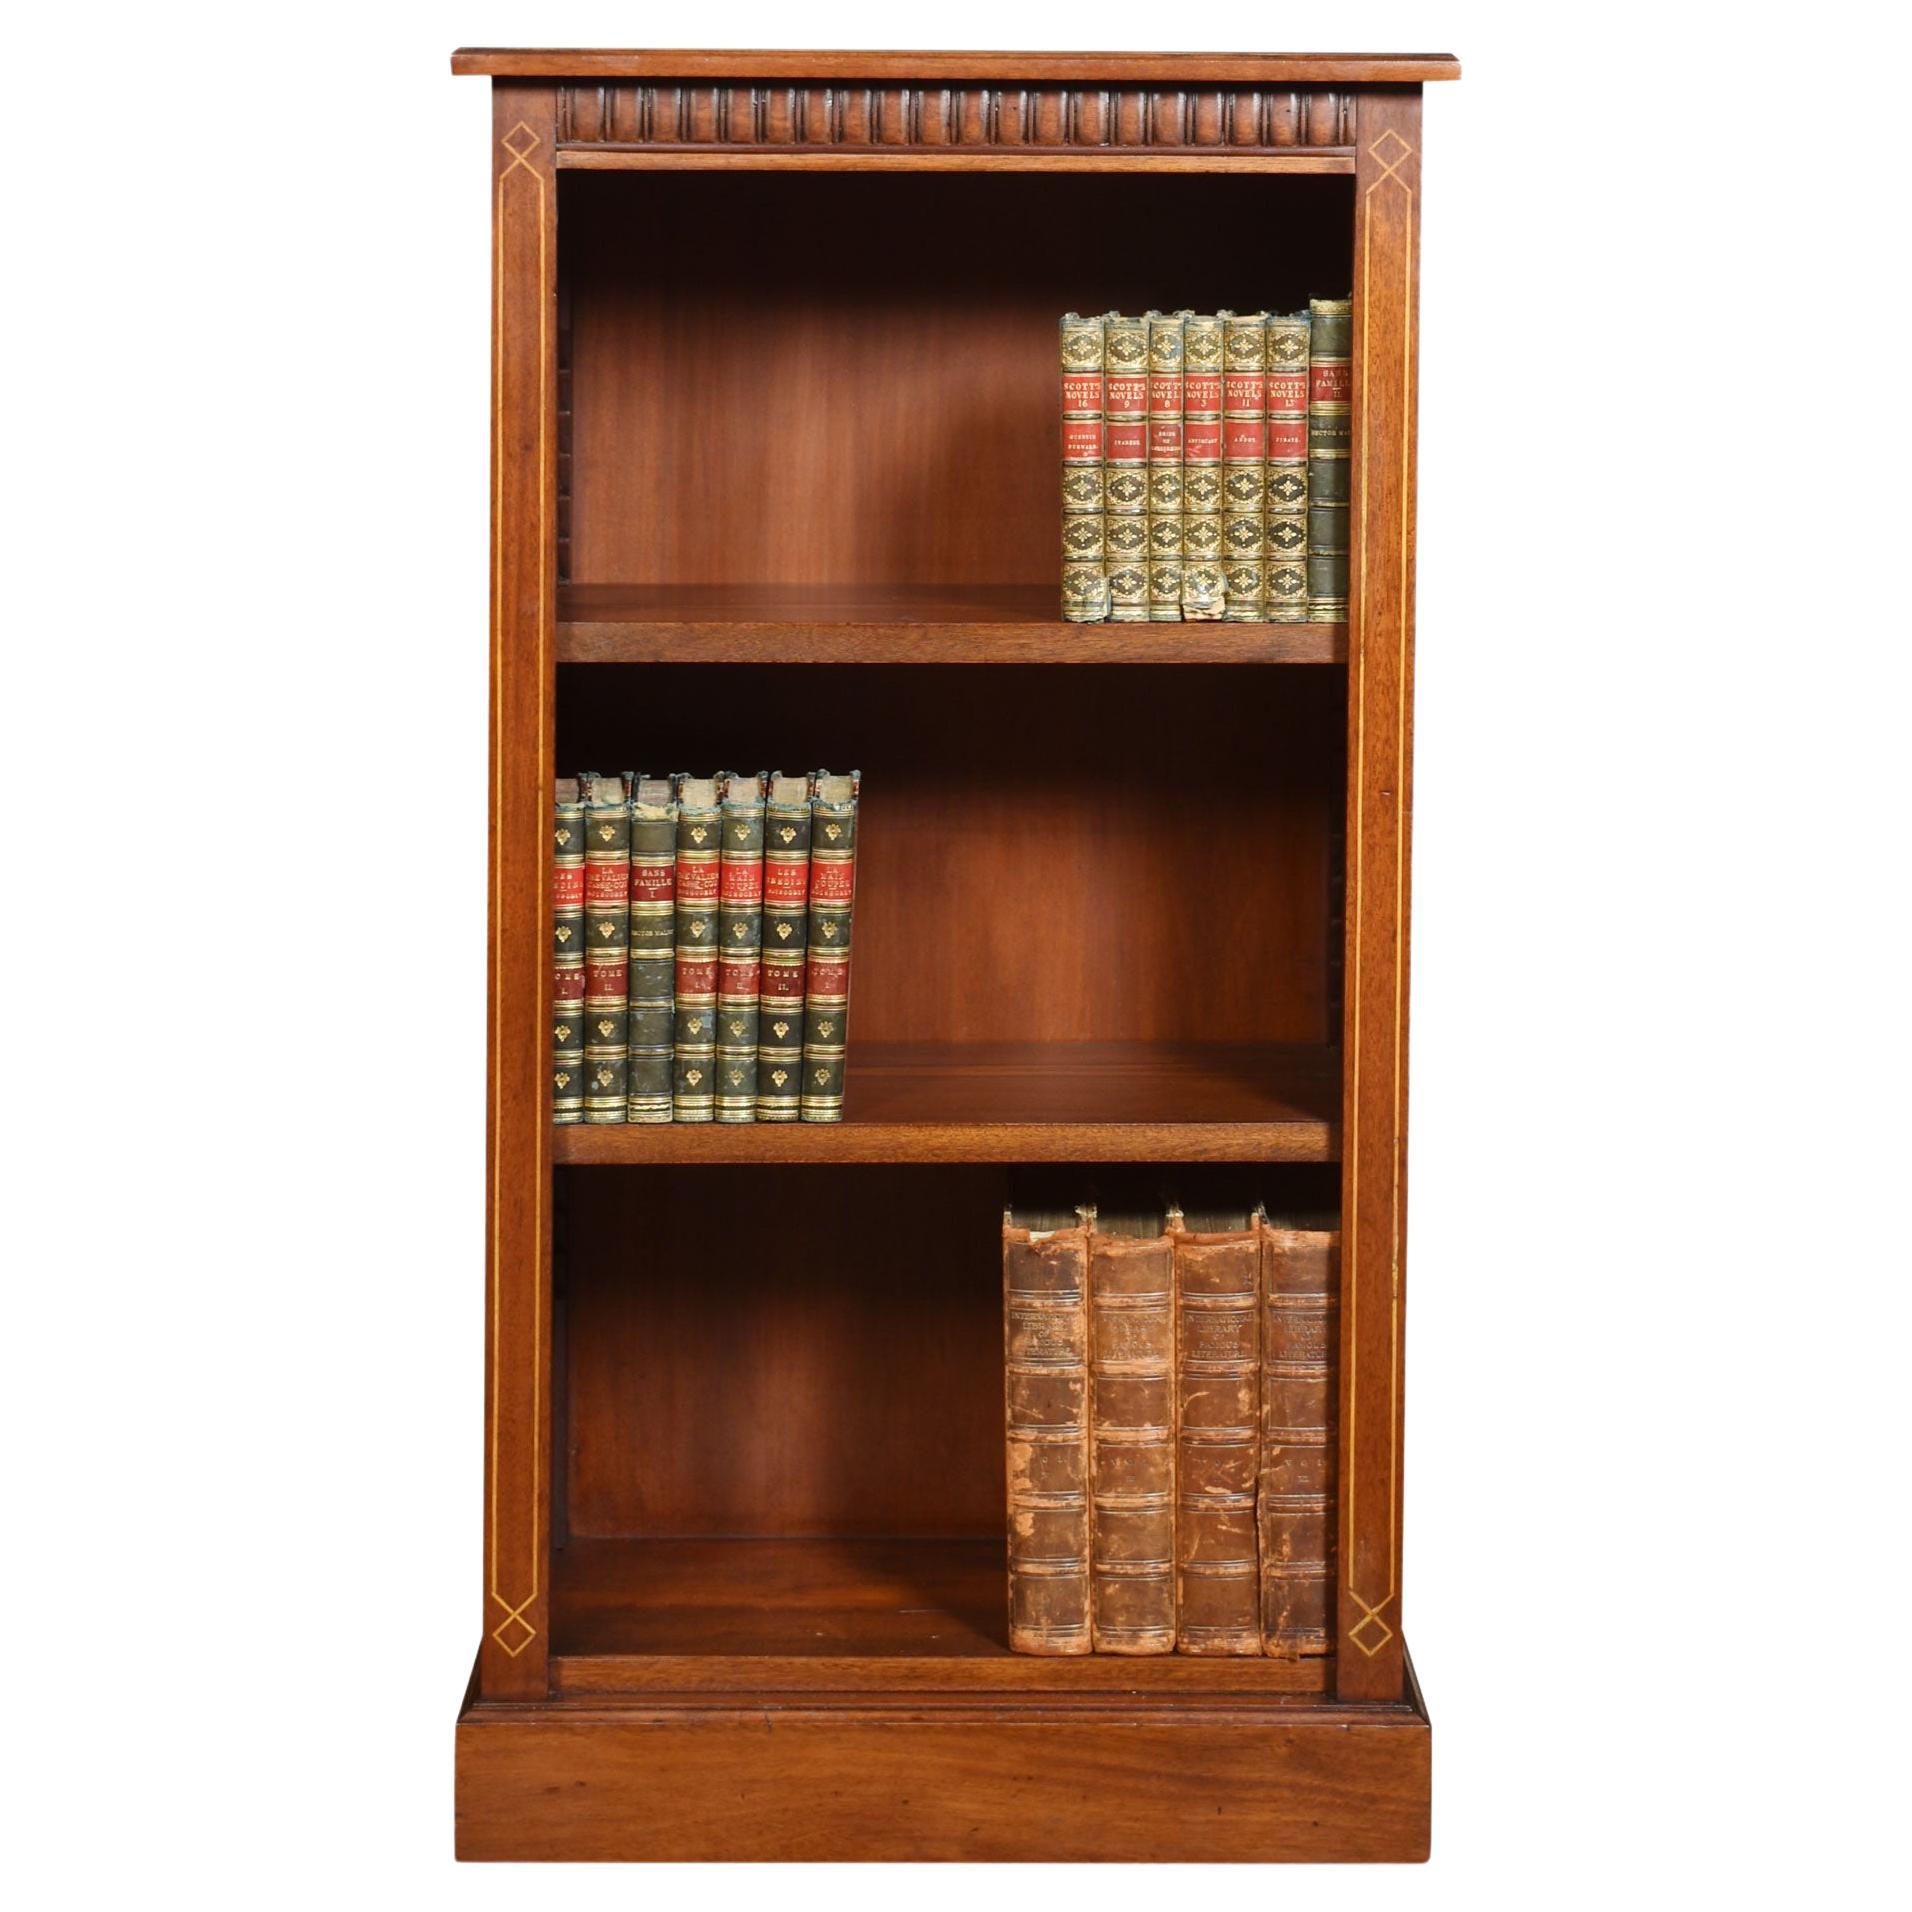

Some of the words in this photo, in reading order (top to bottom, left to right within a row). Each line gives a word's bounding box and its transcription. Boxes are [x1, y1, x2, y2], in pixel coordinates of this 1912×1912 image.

[1108, 383, 1145, 391] SCOTT'S
[1270, 382, 1305, 390] SCOTT'S
[1066, 391, 1100, 399] NOVELS
[1110, 392, 1144, 400] NOVELS
[1187, 390, 1219, 399] NOVELS
[1228, 390, 1262, 398] NOVELS
[1270, 390, 1305, 398] NOVELS
[1124, 400, 1130, 408] 9
[1164, 400, 1171, 408] 8
[1201, 400, 1207, 408] 3
[1242, 399, 1250, 407] 11
[642, 869, 665, 877] SANS
[634, 879, 672, 887] FAMILLE
[768, 970, 798, 978] TOME
